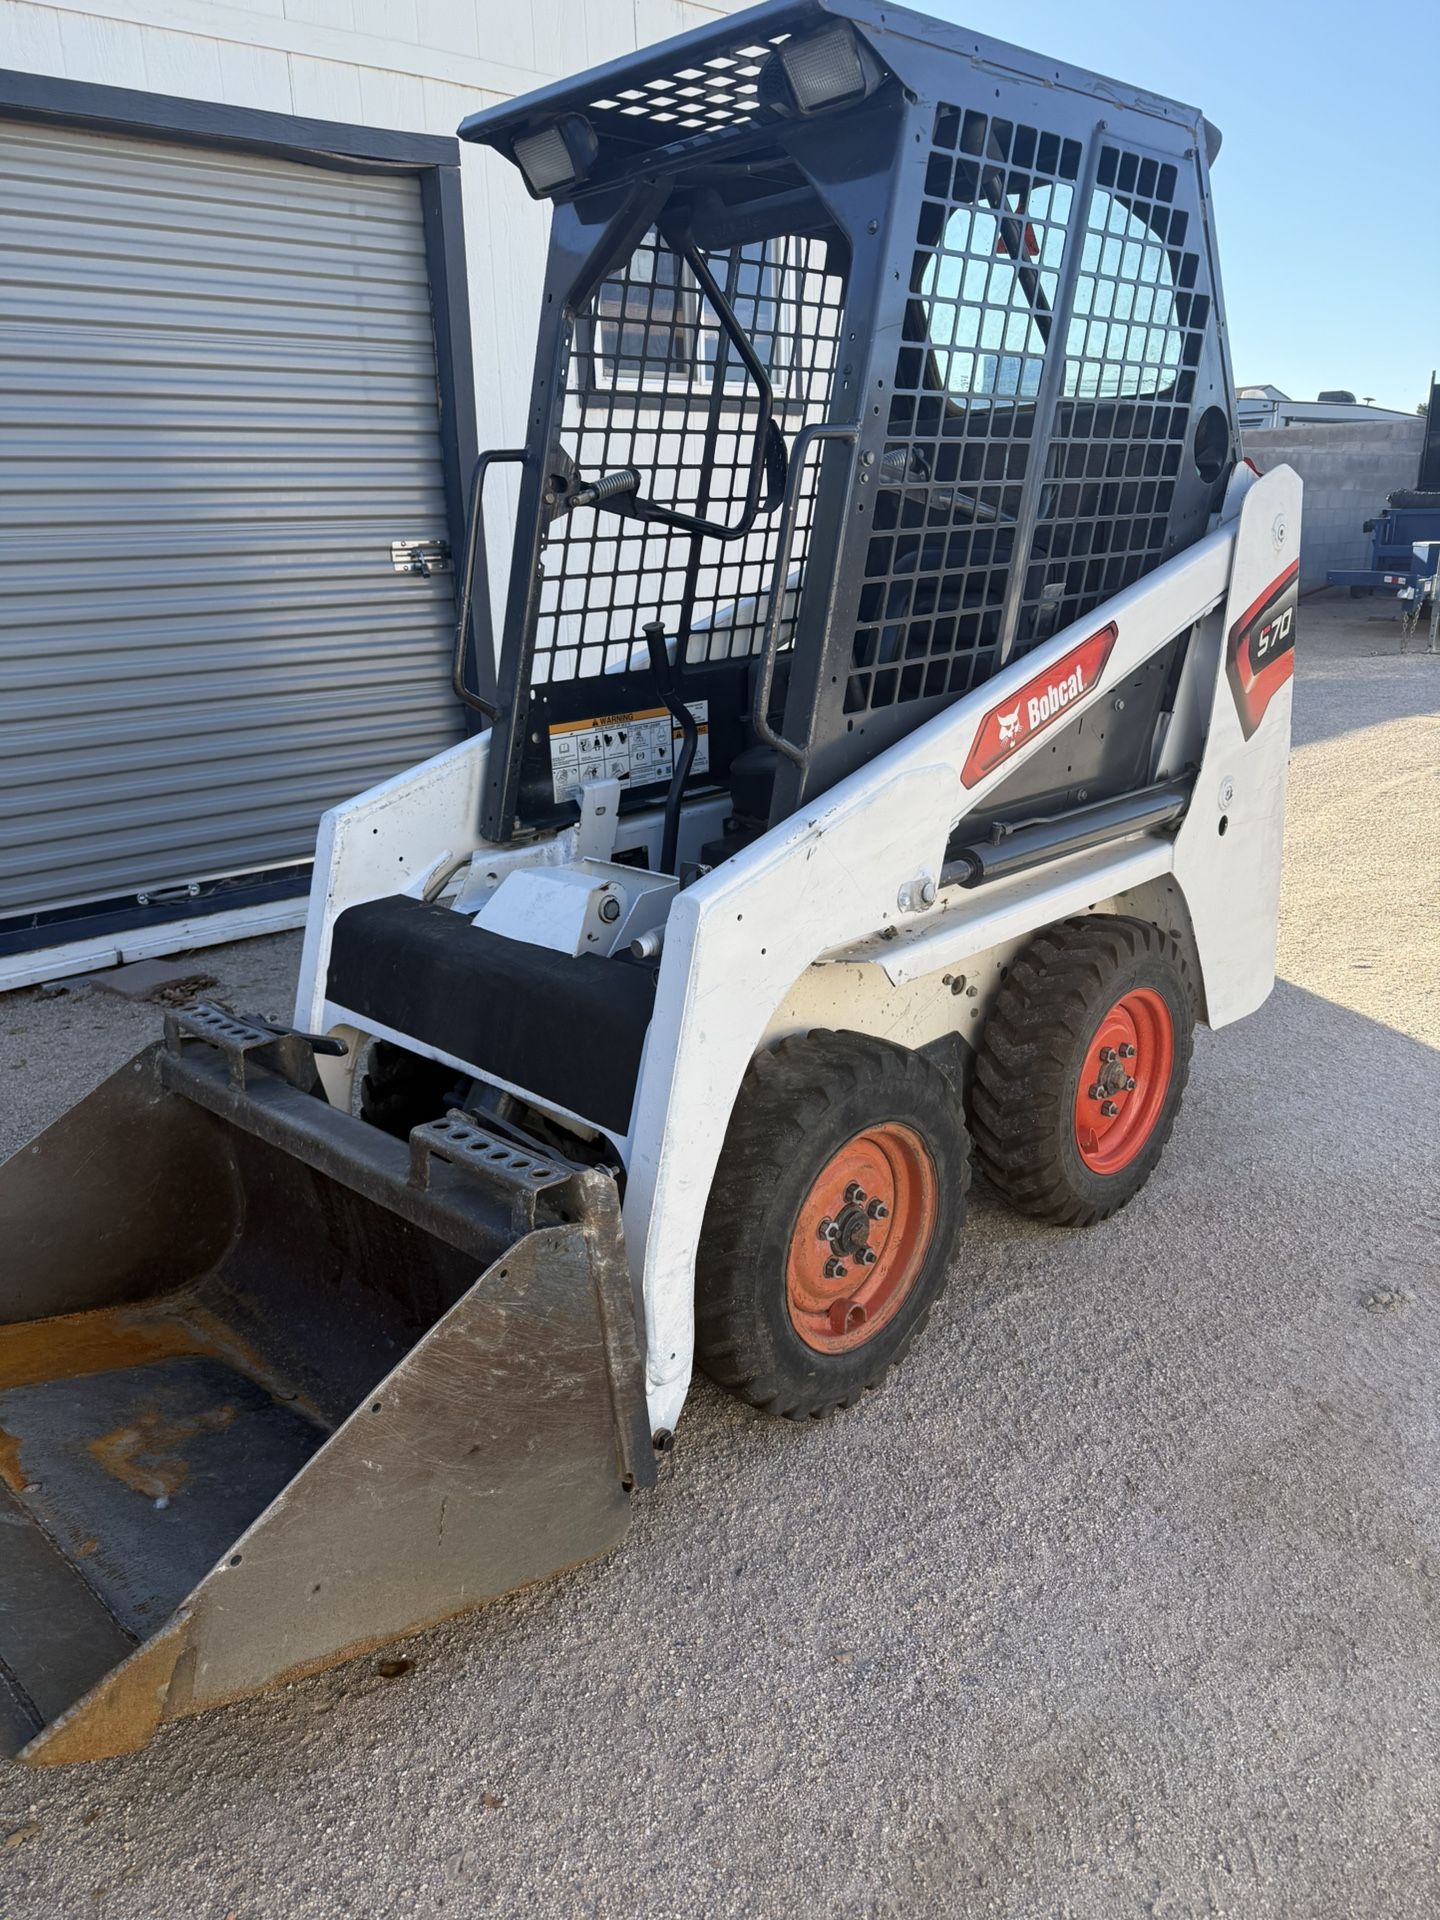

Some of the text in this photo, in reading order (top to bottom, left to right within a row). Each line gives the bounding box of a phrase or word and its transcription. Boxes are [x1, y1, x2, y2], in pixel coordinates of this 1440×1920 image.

[1257, 606, 1293, 658] S70
[600, 713, 634, 725] WARNING
[1027, 664, 1085, 730] Bobcat
